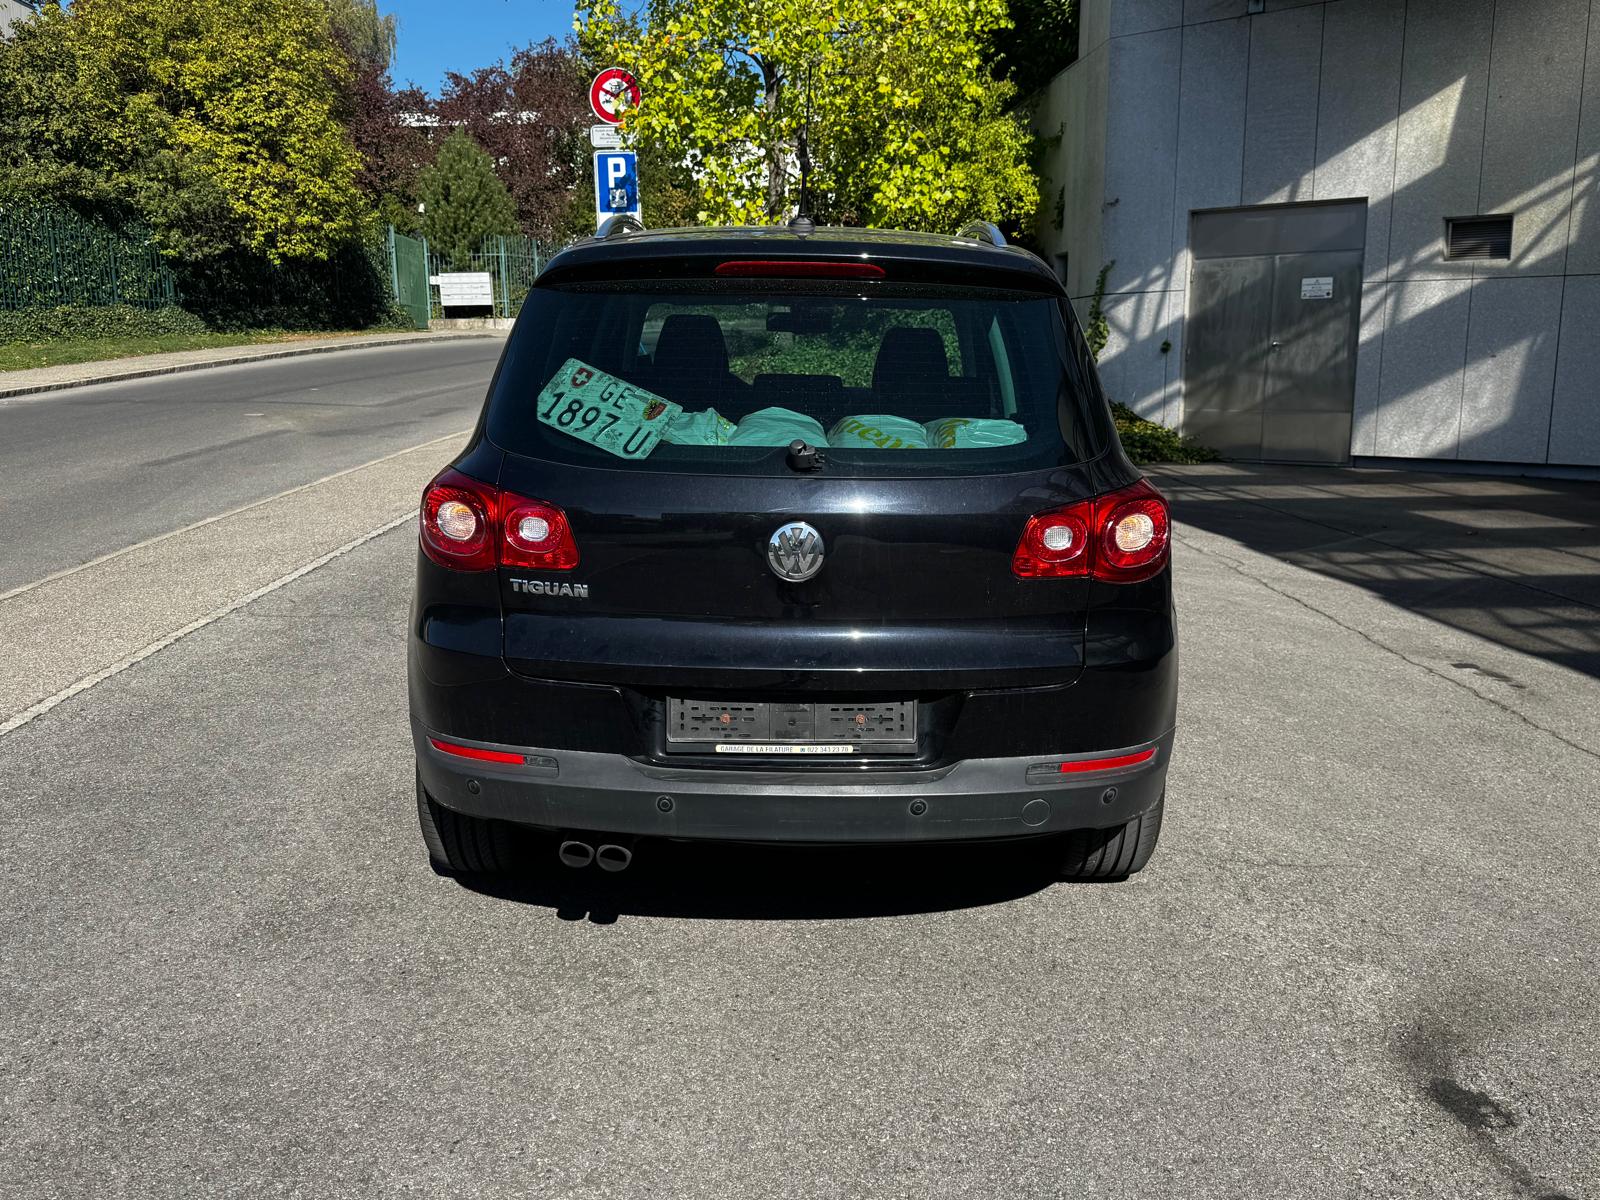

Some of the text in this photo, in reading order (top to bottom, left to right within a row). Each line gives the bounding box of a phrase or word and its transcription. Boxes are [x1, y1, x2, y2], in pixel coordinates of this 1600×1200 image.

[607, 157, 626, 188] P
[600, 382, 636, 410] GE
[541, 391, 654, 456] 1897 U
[509, 578, 589, 598] TIGUAN
